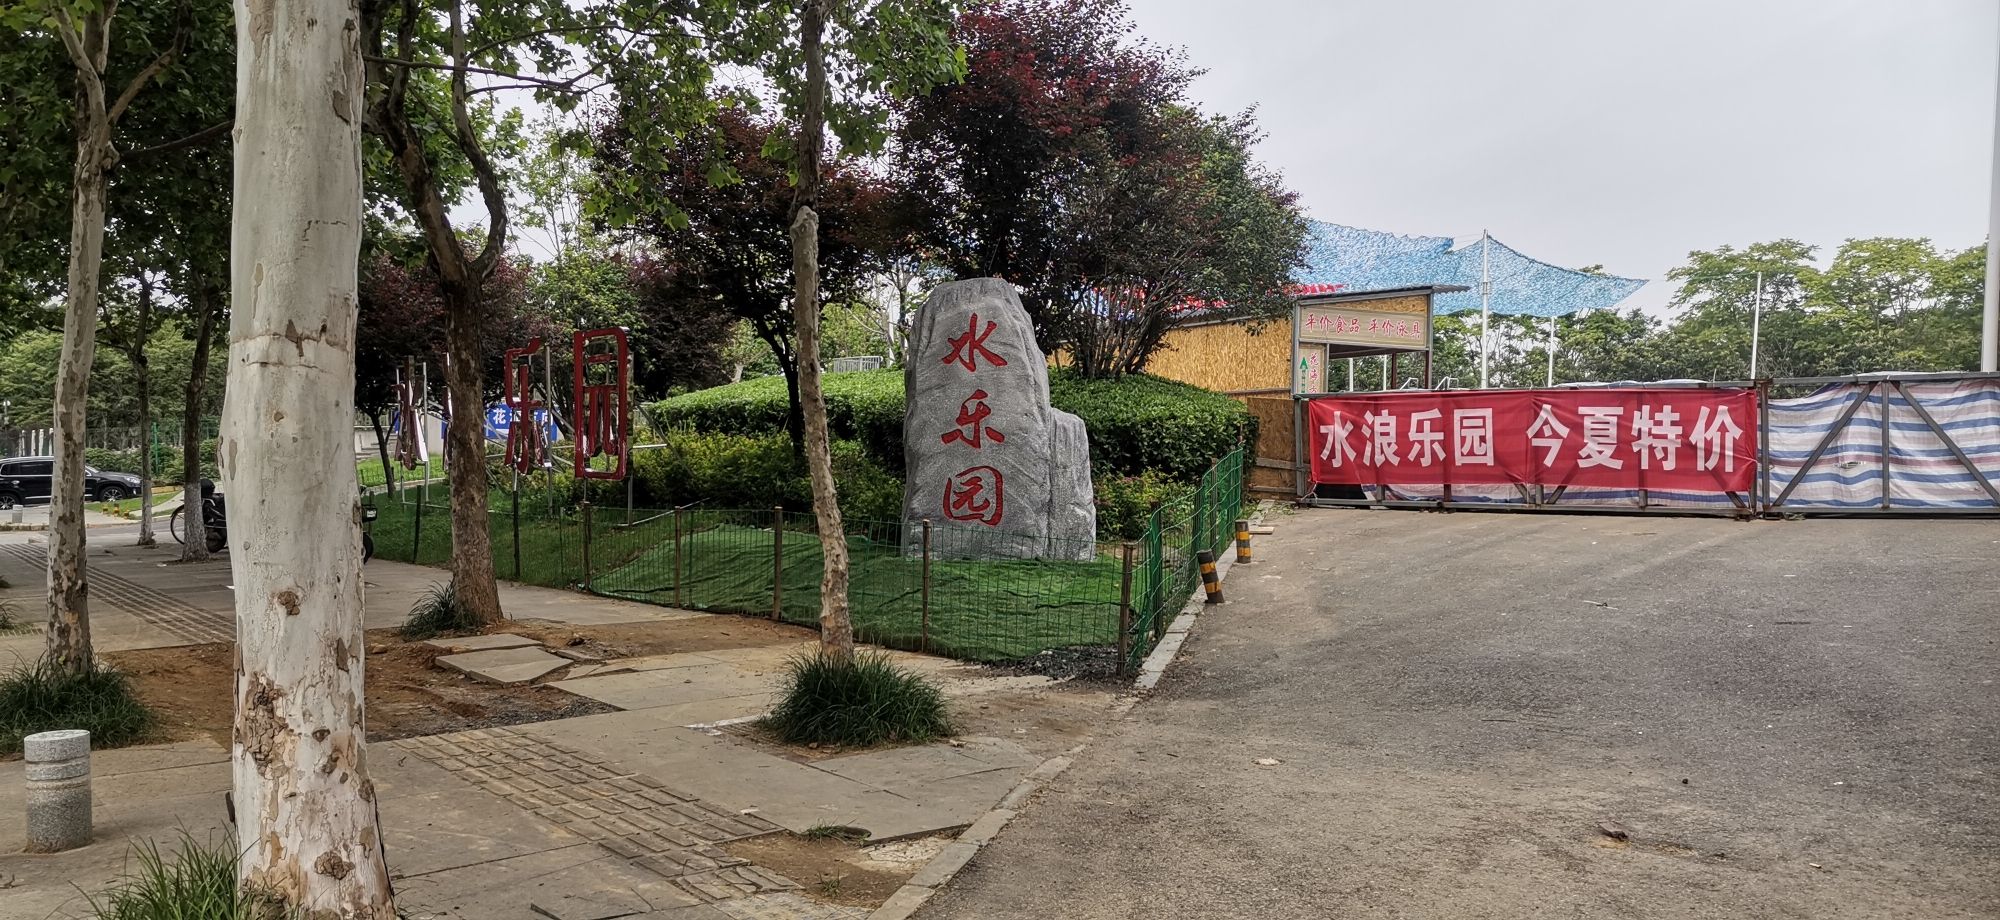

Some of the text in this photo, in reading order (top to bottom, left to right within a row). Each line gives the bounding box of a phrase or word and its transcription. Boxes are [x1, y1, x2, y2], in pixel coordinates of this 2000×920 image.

[1305, 313, 1421, 339] 平价食品 平价泳具
[941, 312, 1008, 527] 水乐园
[1319, 403, 1744, 473] 水浪乐园 今夏特价
